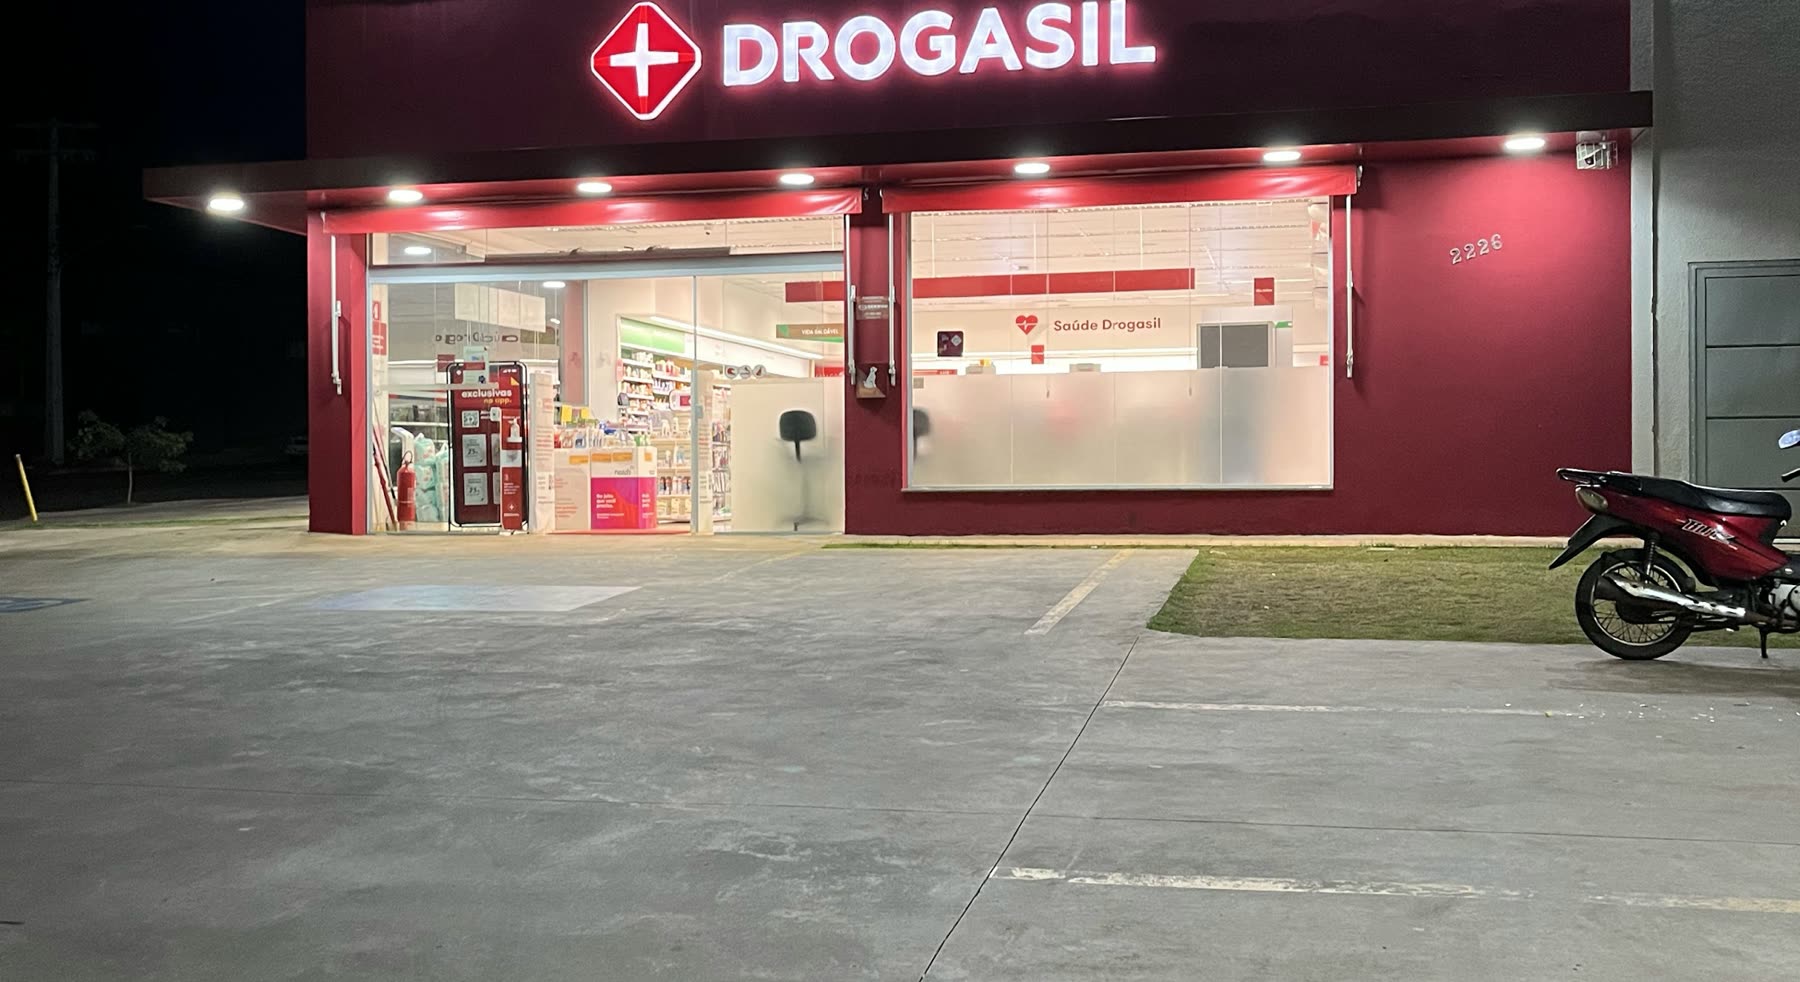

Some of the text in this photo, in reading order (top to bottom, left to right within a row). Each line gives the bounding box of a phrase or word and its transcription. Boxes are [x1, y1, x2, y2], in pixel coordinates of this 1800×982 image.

[723, 0, 1157, 87] DROGASIL
[1449, 233, 1503, 265] 2226
[1053, 317, 1161, 333] Saúde Drogasil
[461, 388, 513, 398] exclusivas
